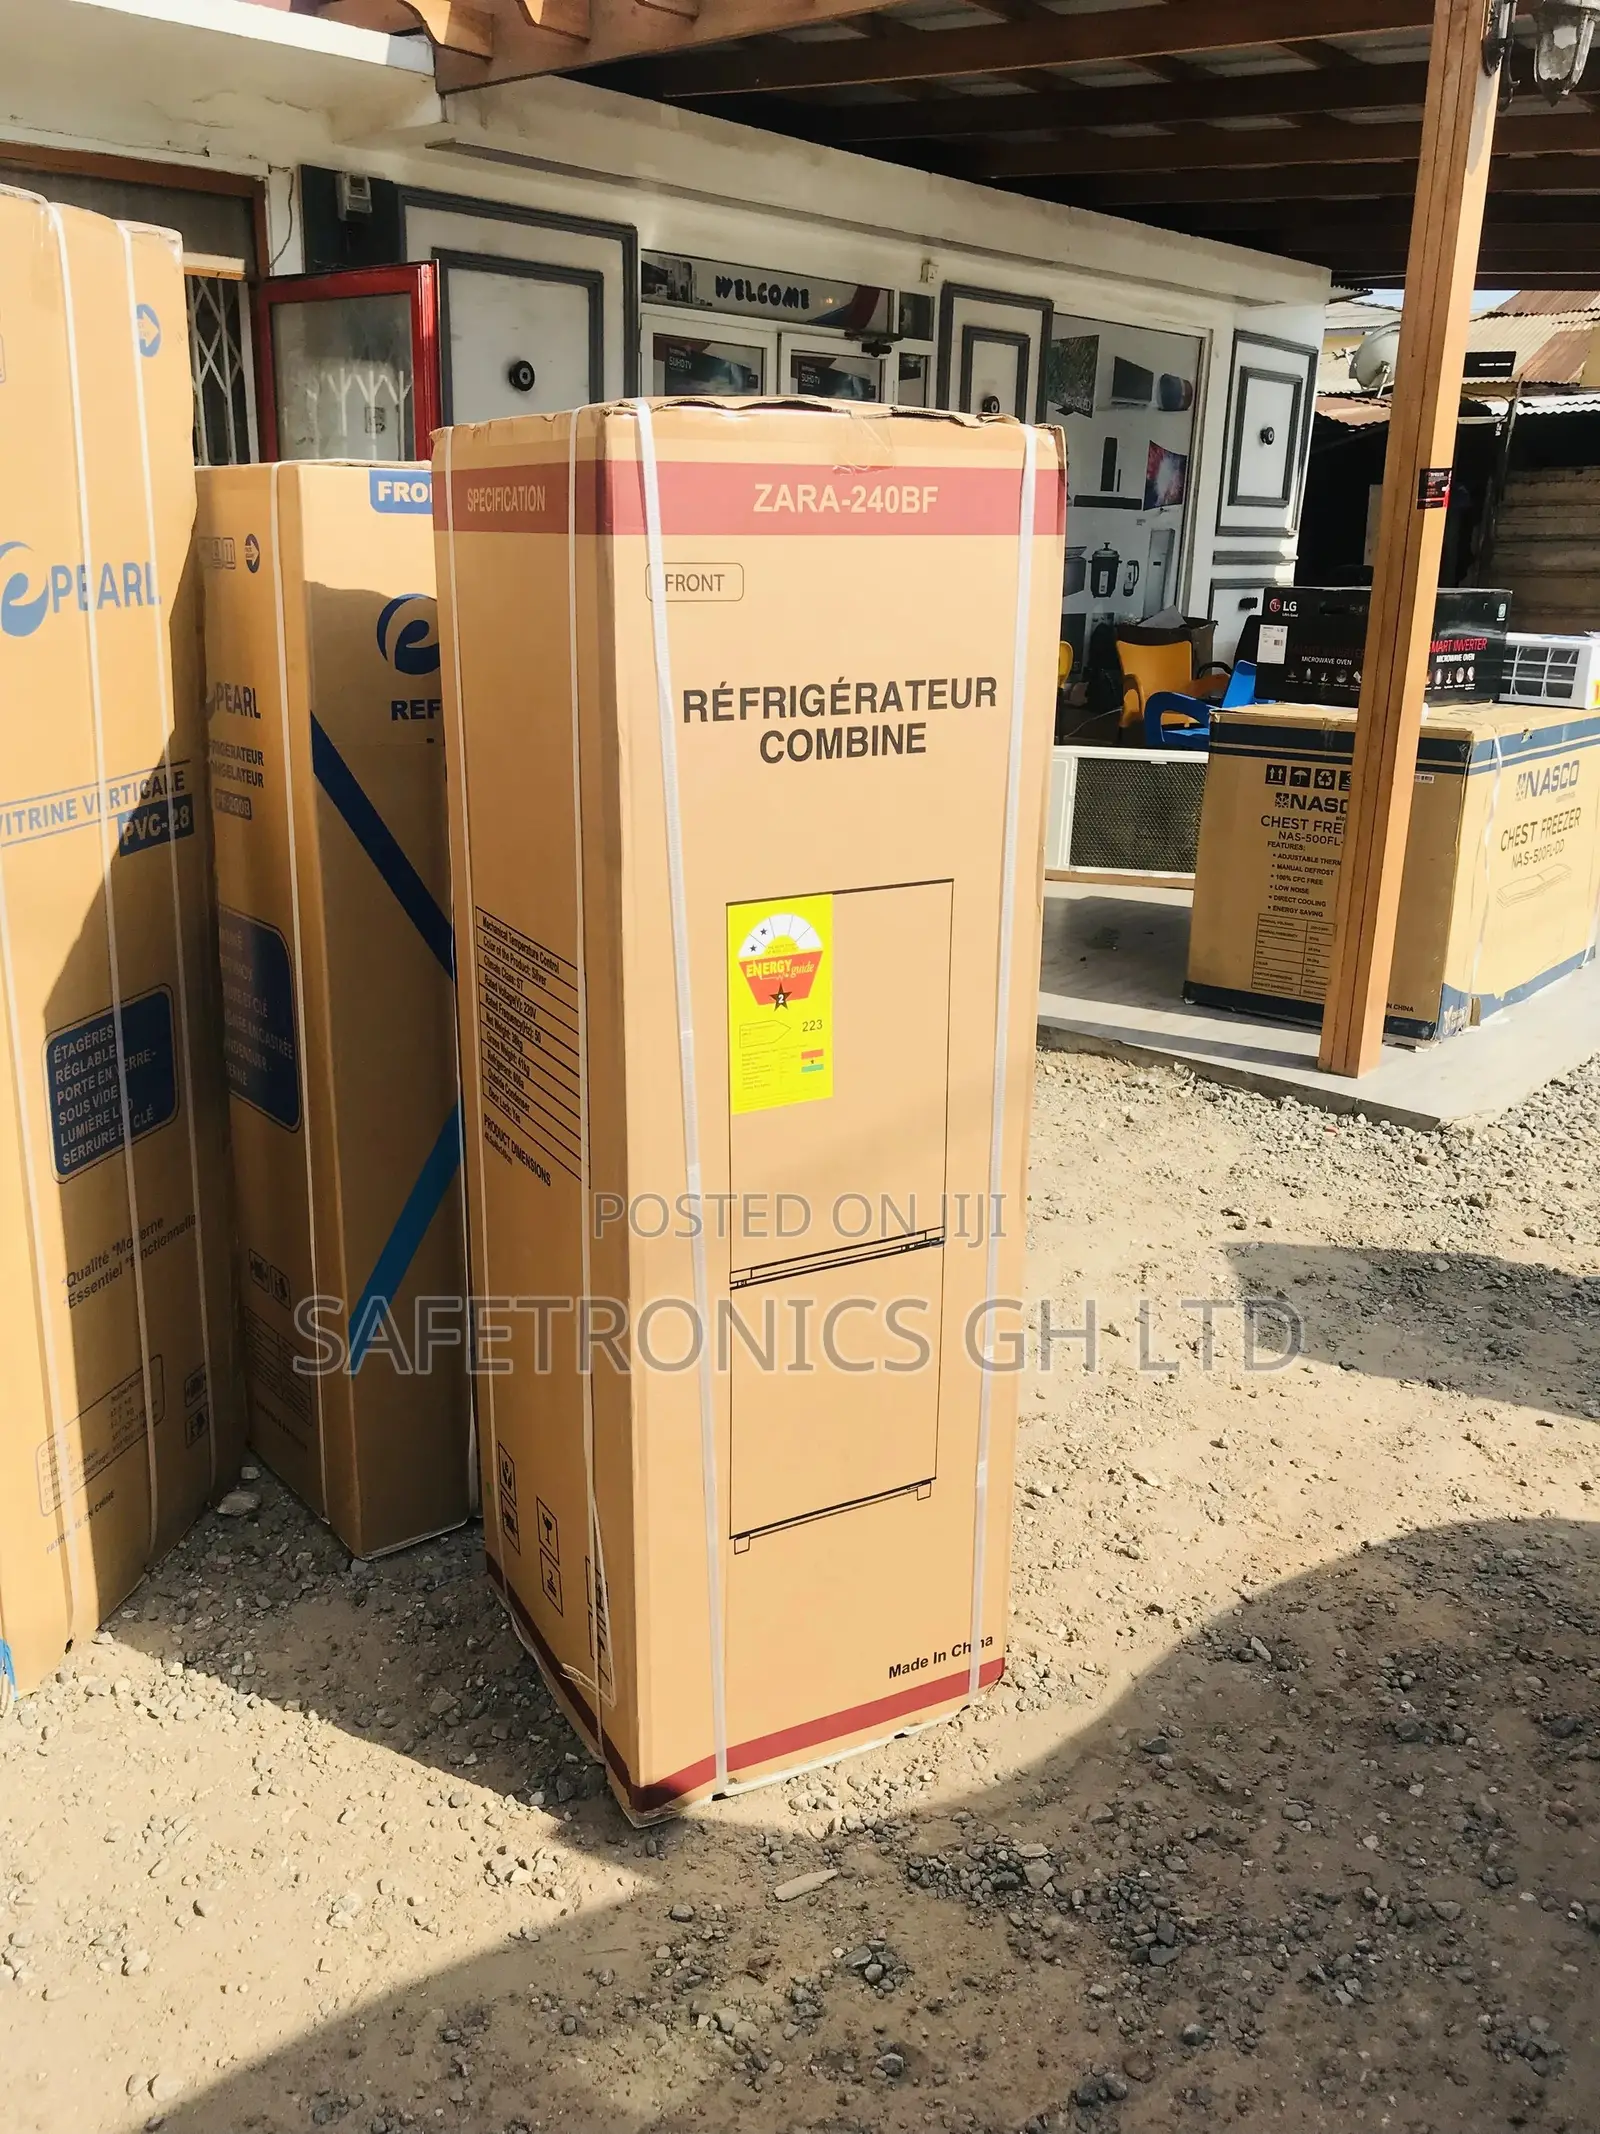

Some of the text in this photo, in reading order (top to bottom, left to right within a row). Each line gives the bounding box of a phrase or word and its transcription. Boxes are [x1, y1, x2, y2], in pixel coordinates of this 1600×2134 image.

[714, 274, 810, 310] WELCOME
[467, 485, 546, 512] SPECIFICATION
[753, 483, 938, 515] ZARA-240BF
[51, 561, 161, 613] PEARL
[664, 572, 726, 593] FRONT
[1283, 601, 1297, 612] LG
[1454, 637, 1487, 651] INVERTER
[1301, 655, 1352, 666] MICROWAVE OVEN
[215, 682, 261, 719] PEARL
[683, 676, 997, 723] RÉFRIGÉRATEUR
[759, 722, 927, 764] COMBINE
[1525, 760, 1580, 799] NASCO
[121, 804, 190, 846] PVC-28
[1260, 815, 1309, 830] CHEST
[1501, 807, 1581, 852] CHEST FREEZER
[1267, 841, 1306, 851] FEATURES:
[1277, 853, 1318, 864] ADJUSTABLE
[1276, 863, 1334, 876] MANUAL DEFROST
[1276, 874, 1292, 882] 100%
[1307, 878, 1323, 886] FREE
[1273, 894, 1326, 907] DIRECT COOLING
[1274, 884, 1309, 895] LOW NOISE
[1272, 905, 1323, 917] ENERGY SAVING
[482, 915, 559, 975] Mechanical Temperature Control
[483, 935, 546, 987] Color of the Product: Silver
[746, 959, 815, 978] ENERGY guide
[517, 976, 523, 992] ST
[778, 994, 784, 1004] 2
[1393, 1004, 1414, 1013] CHINA
[802, 1019, 823, 1032] 223
[54, 1023, 114, 1063] ÉTAGÈRES
[57, 1077, 95, 1106] PORTE
[98, 1070, 112, 1086] EN
[504, 1081, 530, 1114] Condenser
[59, 1085, 118, 1126] SOUS VIDE
[512, 1106, 520, 1125] Yes
[60, 1098, 133, 1147] LUMIÈRE LD
[63, 1127, 116, 1167] SERRURE
[133, 1105, 154, 1129] CLÉ
[484, 1112, 511, 1149] PRODUCT
[511, 1139, 551, 1187] DIMENSIONS
[889, 1658, 929, 1679] Made
[933, 1651, 947, 1665] In
